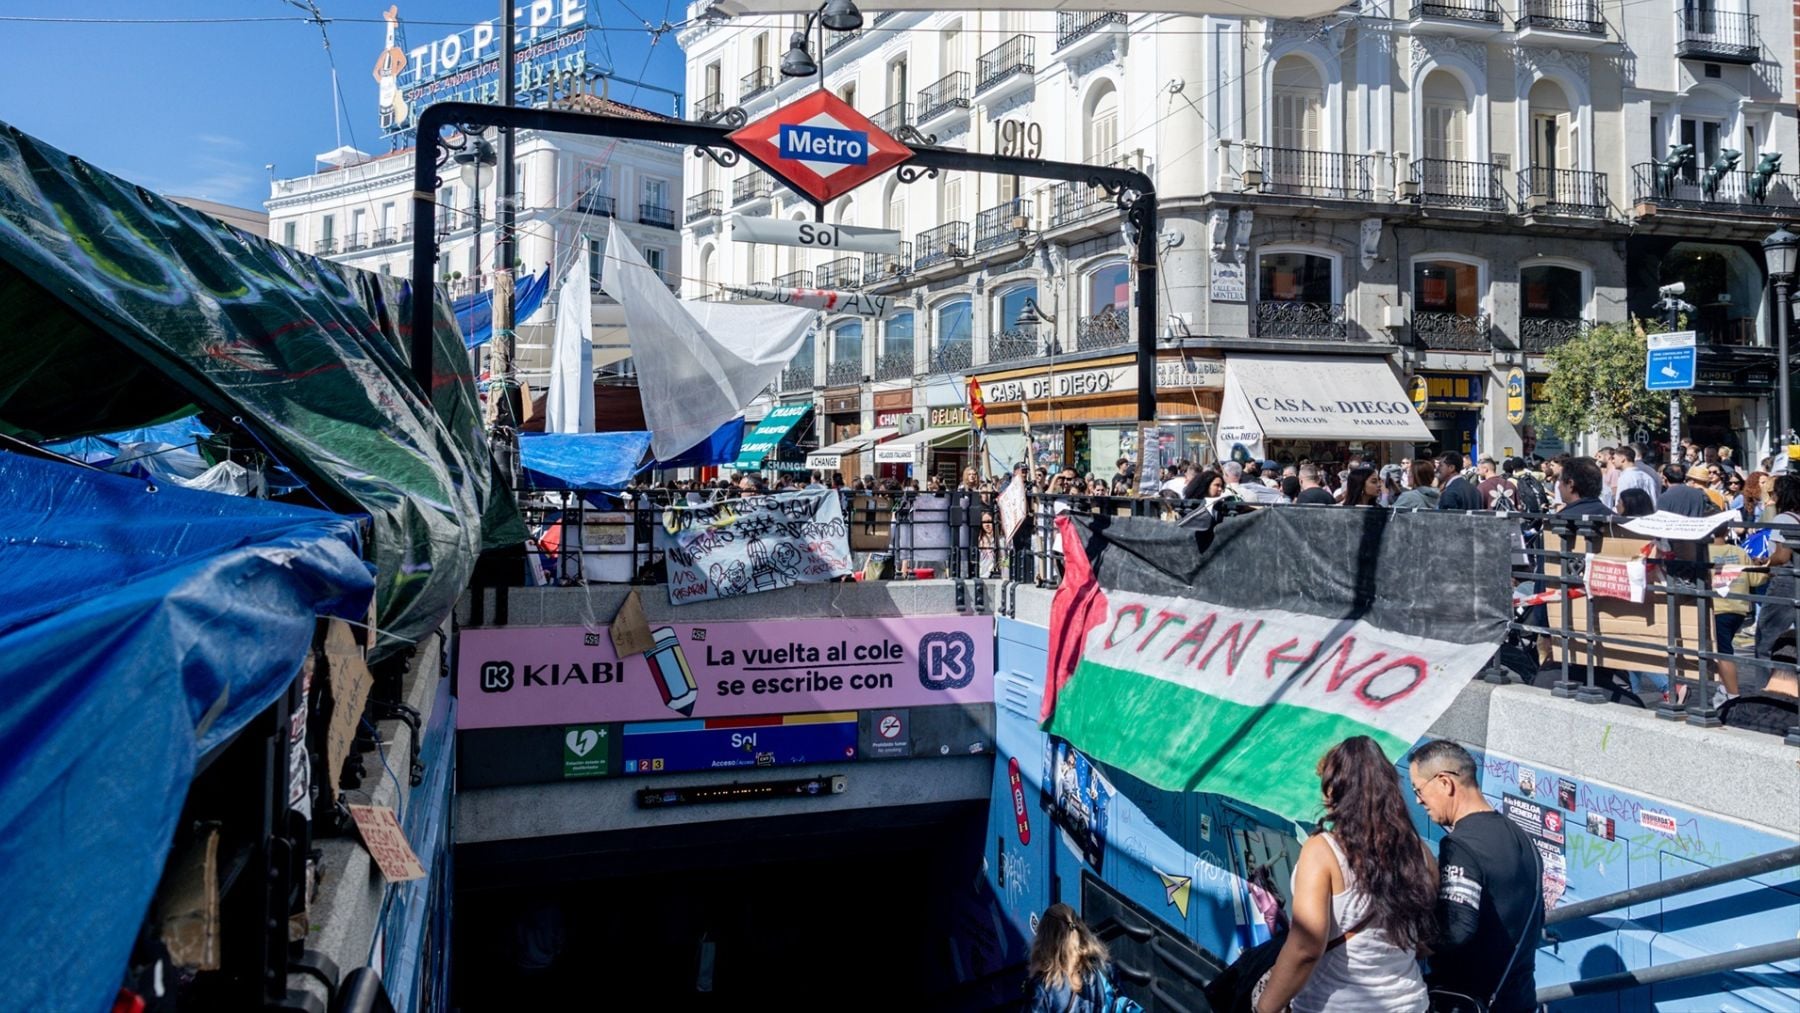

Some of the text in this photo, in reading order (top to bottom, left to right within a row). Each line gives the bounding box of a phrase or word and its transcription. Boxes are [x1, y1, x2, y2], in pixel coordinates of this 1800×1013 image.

[411, 34, 462, 81] TIO
[514, 30, 585, 63] BOTELLADO
[788, 130, 862, 157] Metro
[995, 119, 1043, 159] 1919
[799, 225, 840, 247] Sol
[1212, 291, 1244, 300] MONTERA
[990, 371, 1112, 402] CASA DE DIEGO
[1254, 396, 1410, 415] CASA DE DIEGO
[1274, 415, 1409, 427] ABANICOS PARAGUAS
[814, 457, 838, 467] CHANGE
[706, 639, 903, 667] La vuelta al cole
[1103, 602, 1429, 709] OTAN NO
[523, 661, 624, 687] KIABI
[716, 669, 893, 697] se escribe con
[731, 732, 757, 748] Sol
[711, 759, 736, 768] Acceso
[1508, 805, 1542, 823] GENERAL
[1512, 798, 1541, 814] HUELGA
